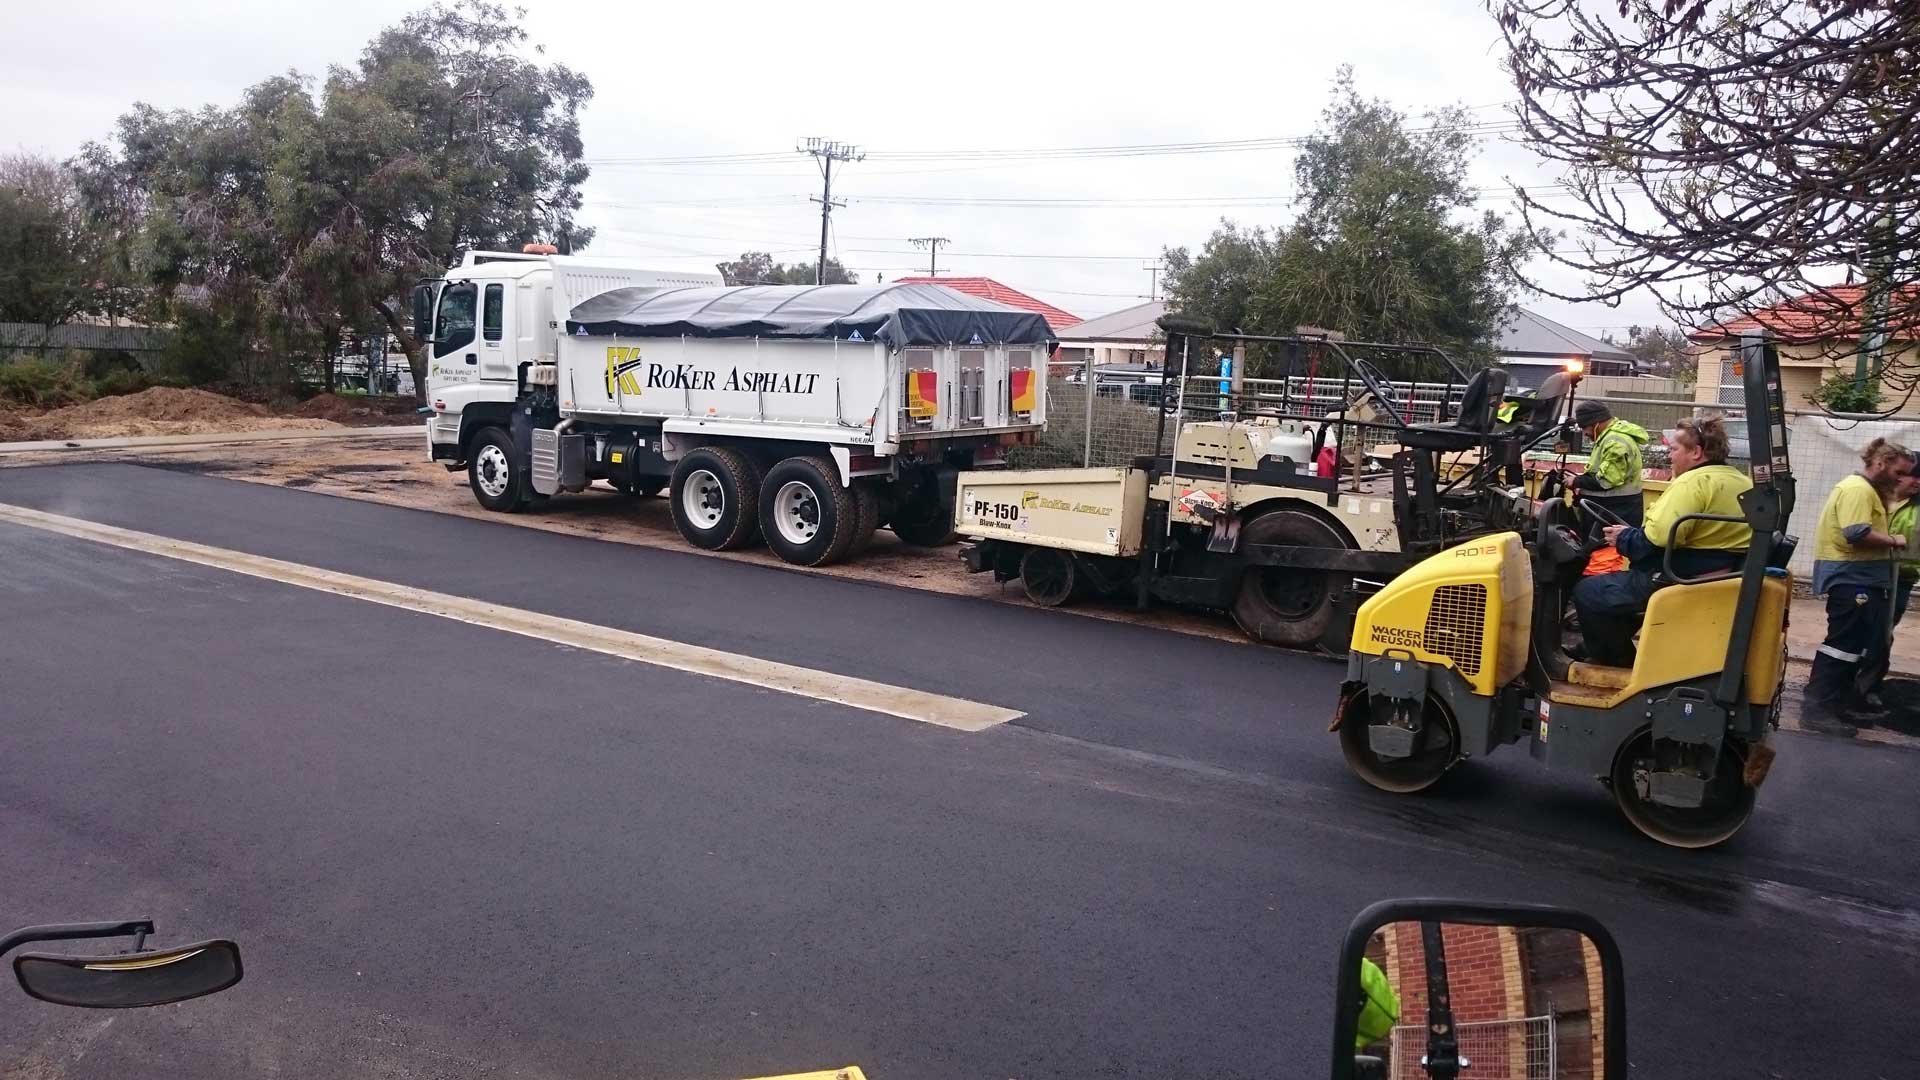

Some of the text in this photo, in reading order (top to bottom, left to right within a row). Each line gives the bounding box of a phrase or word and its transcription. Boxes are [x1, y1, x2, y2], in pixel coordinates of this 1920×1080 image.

[722, 365, 820, 395] ASPHALT
[974, 500, 1019, 521] PF-150
[979, 518, 1012, 530] Blaw-Knox
[1455, 546, 1498, 558] RD12
[1371, 625, 1422, 640] WACKER
[1371, 633, 1422, 649] NEUSON
